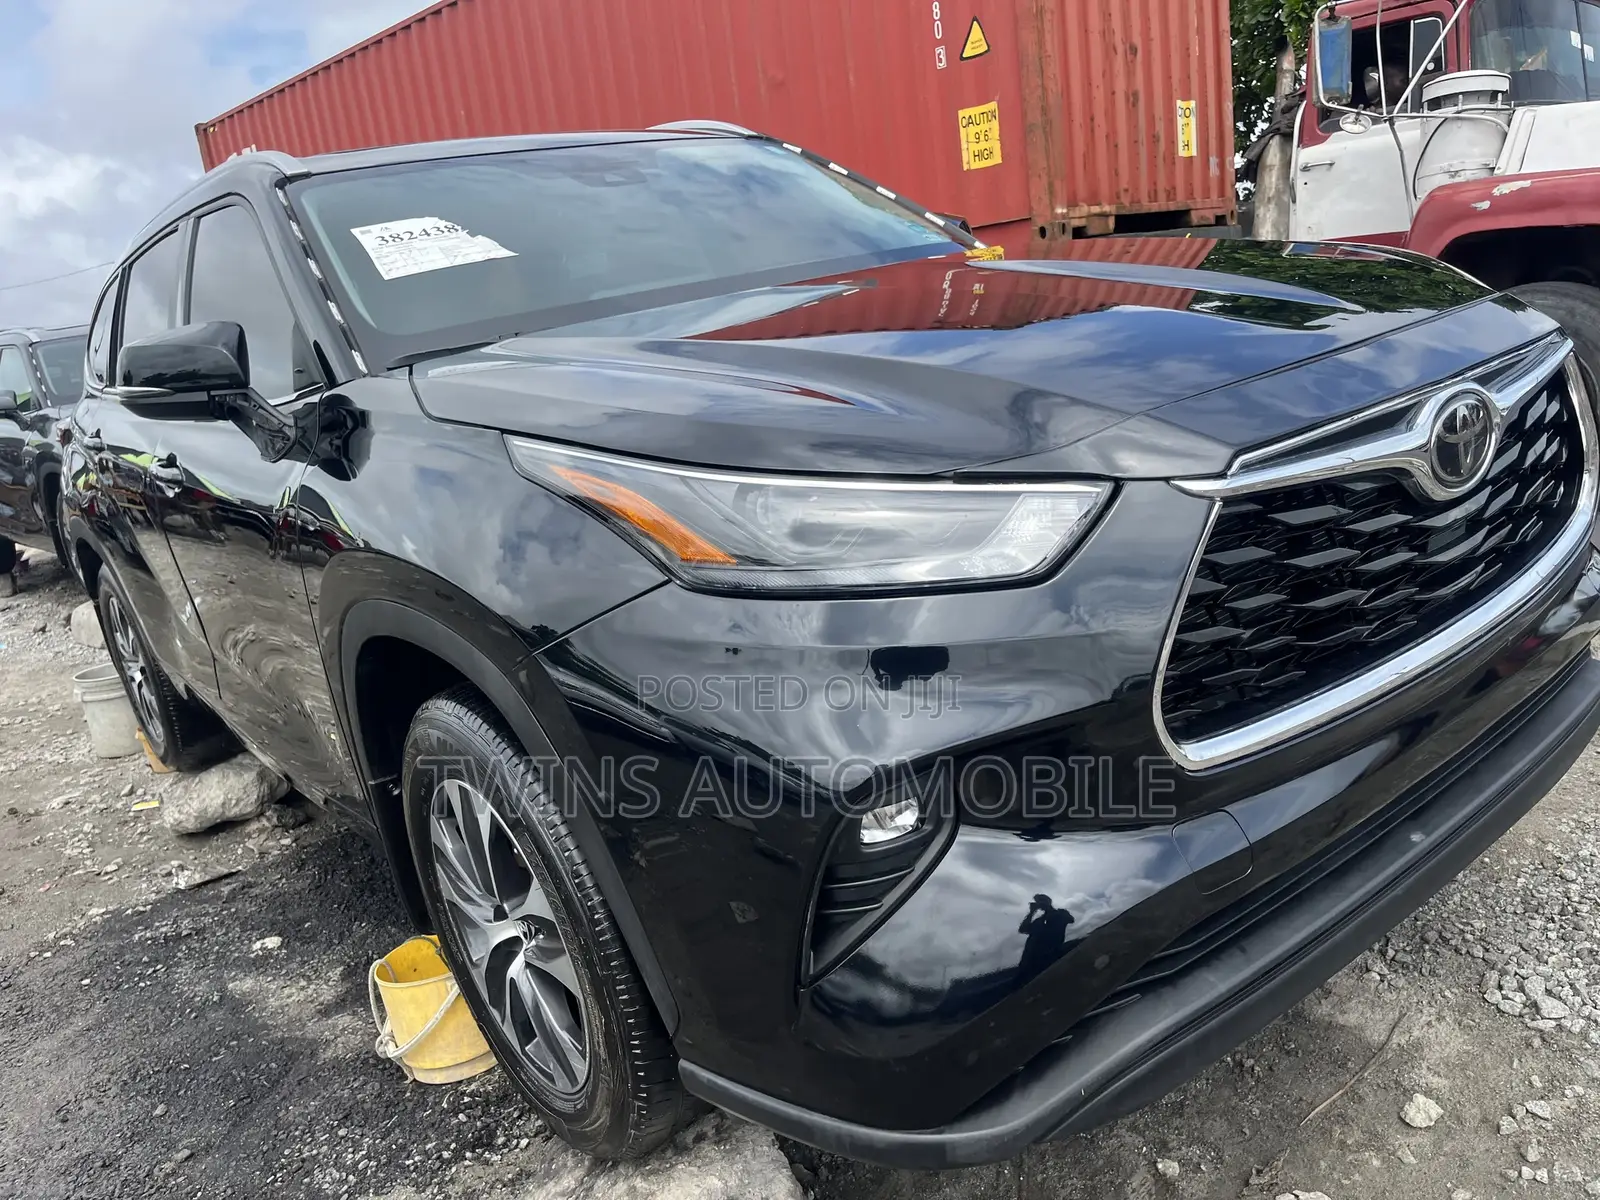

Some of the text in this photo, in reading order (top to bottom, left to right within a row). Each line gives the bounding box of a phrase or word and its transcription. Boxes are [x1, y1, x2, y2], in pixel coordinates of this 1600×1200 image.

[961, 108, 997, 128] CAUTION
[973, 147, 994, 163] HIGH
[374, 223, 460, 246] 382438
